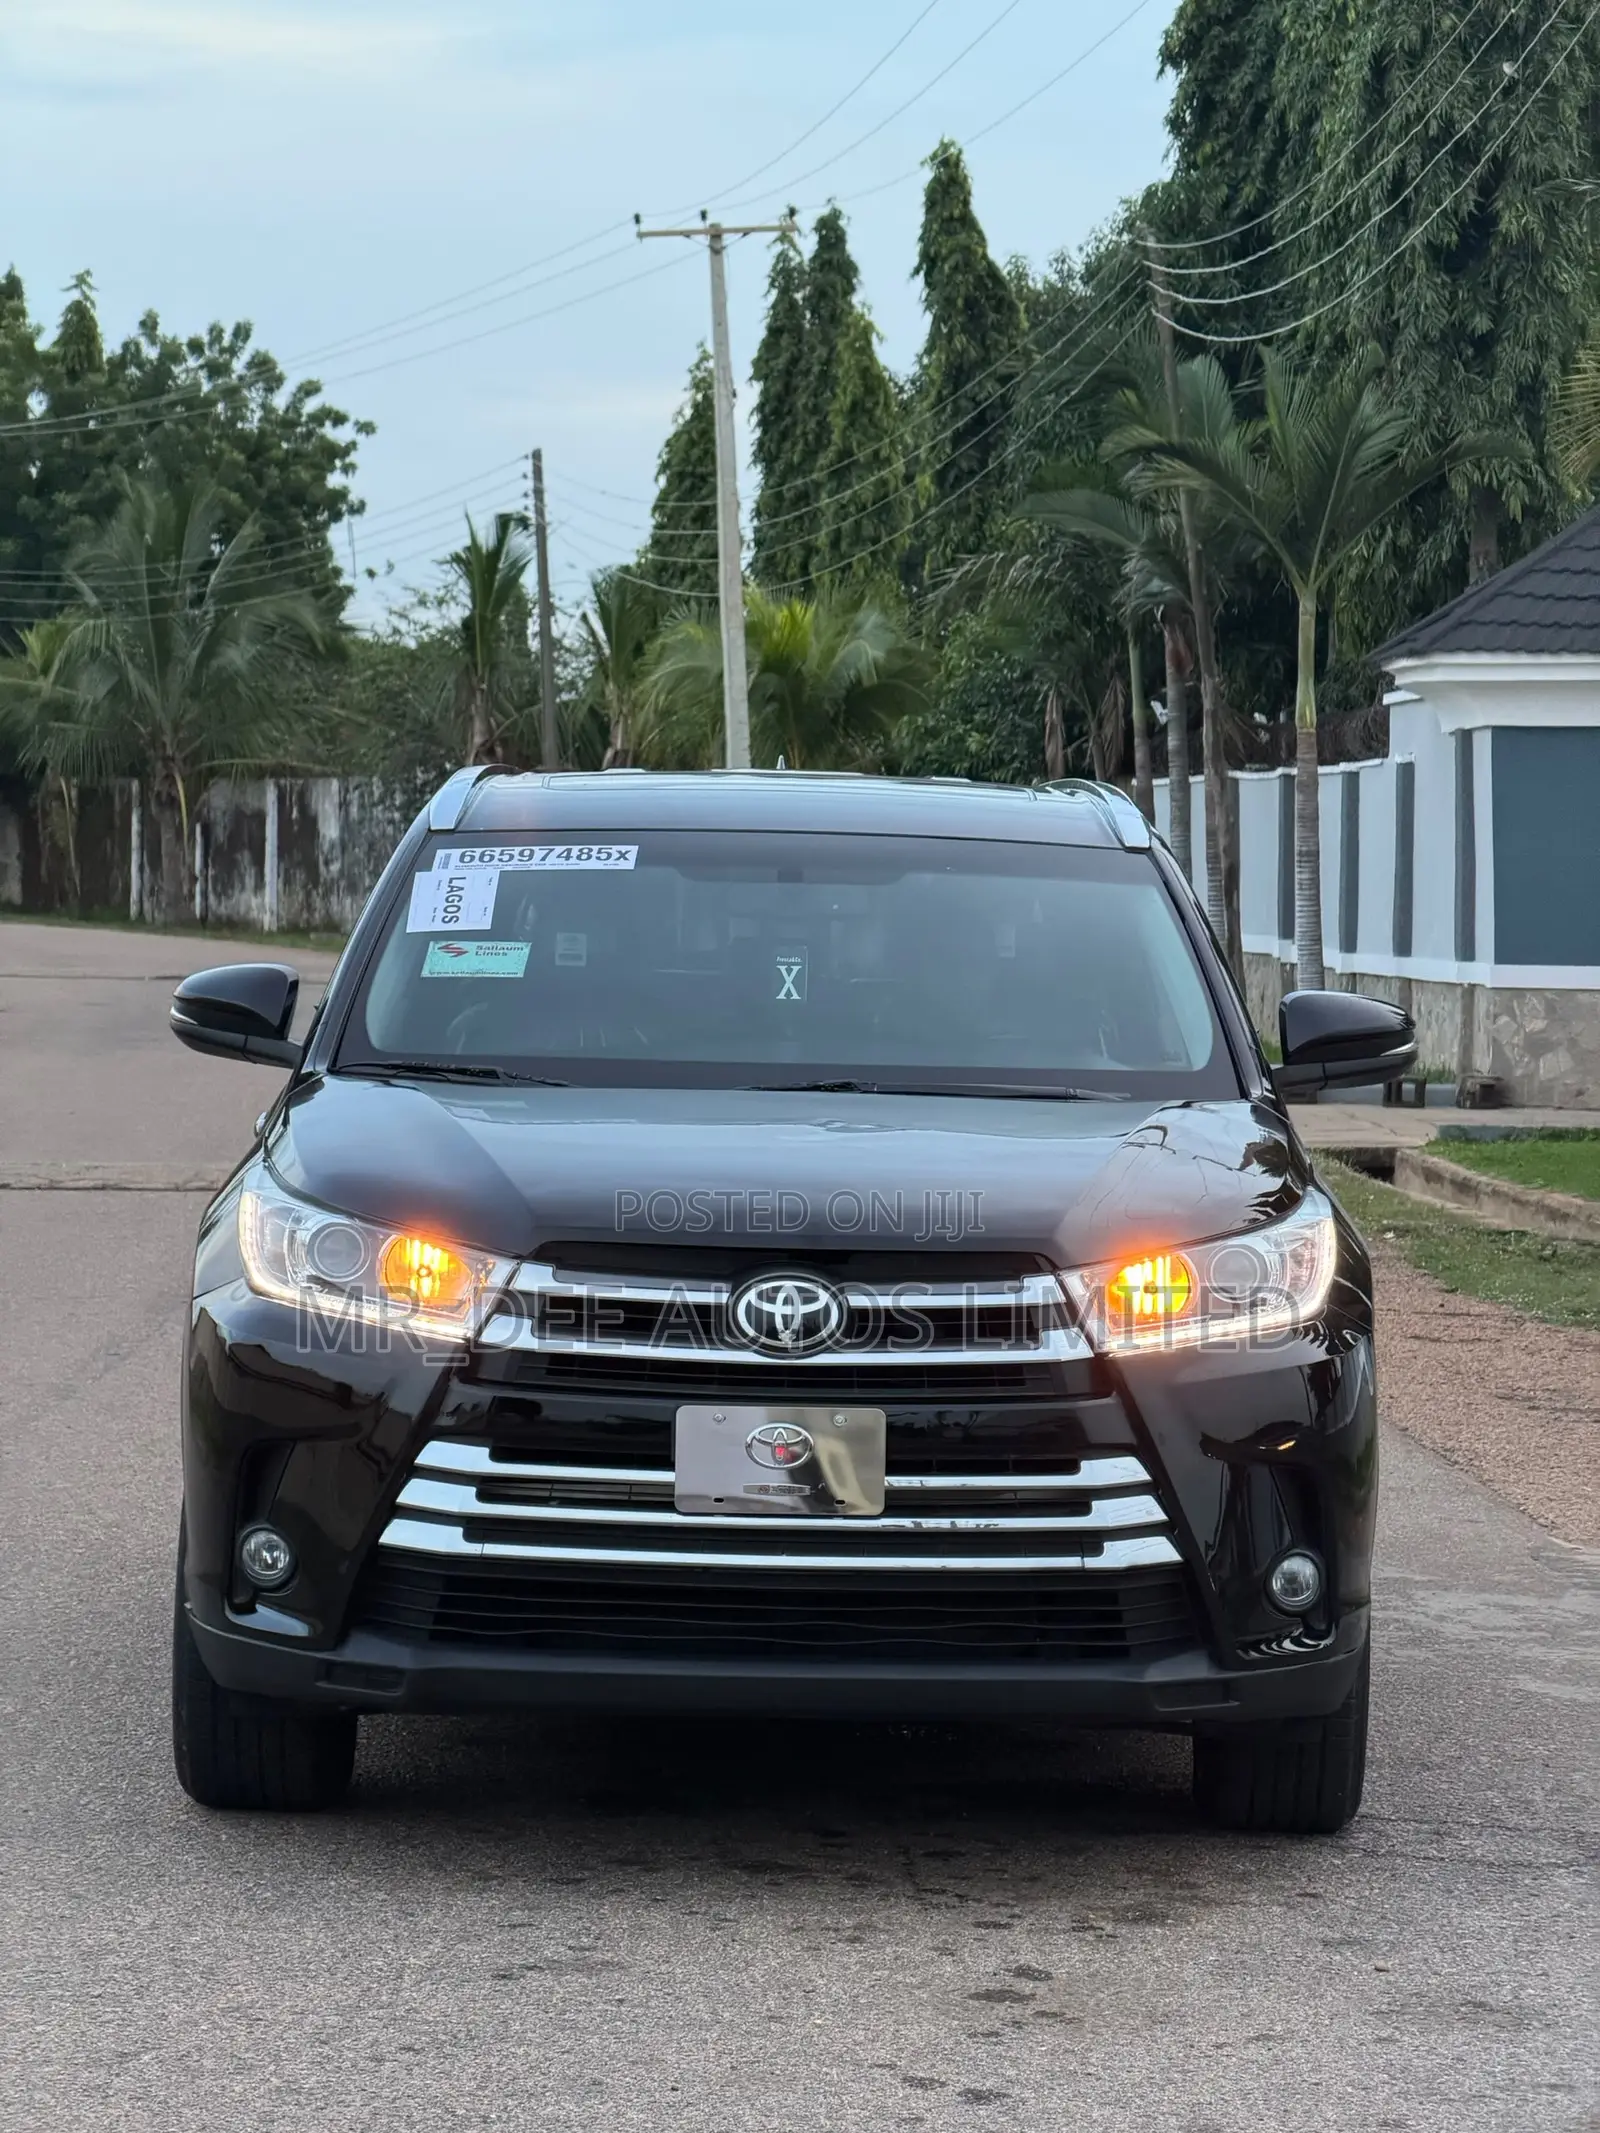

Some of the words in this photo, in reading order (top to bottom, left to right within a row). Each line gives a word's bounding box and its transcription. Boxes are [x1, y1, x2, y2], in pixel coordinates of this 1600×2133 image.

[459, 846, 632, 864] 66597485x
[441, 876, 467, 925] LAGOS
[776, 965, 802, 1000] X
